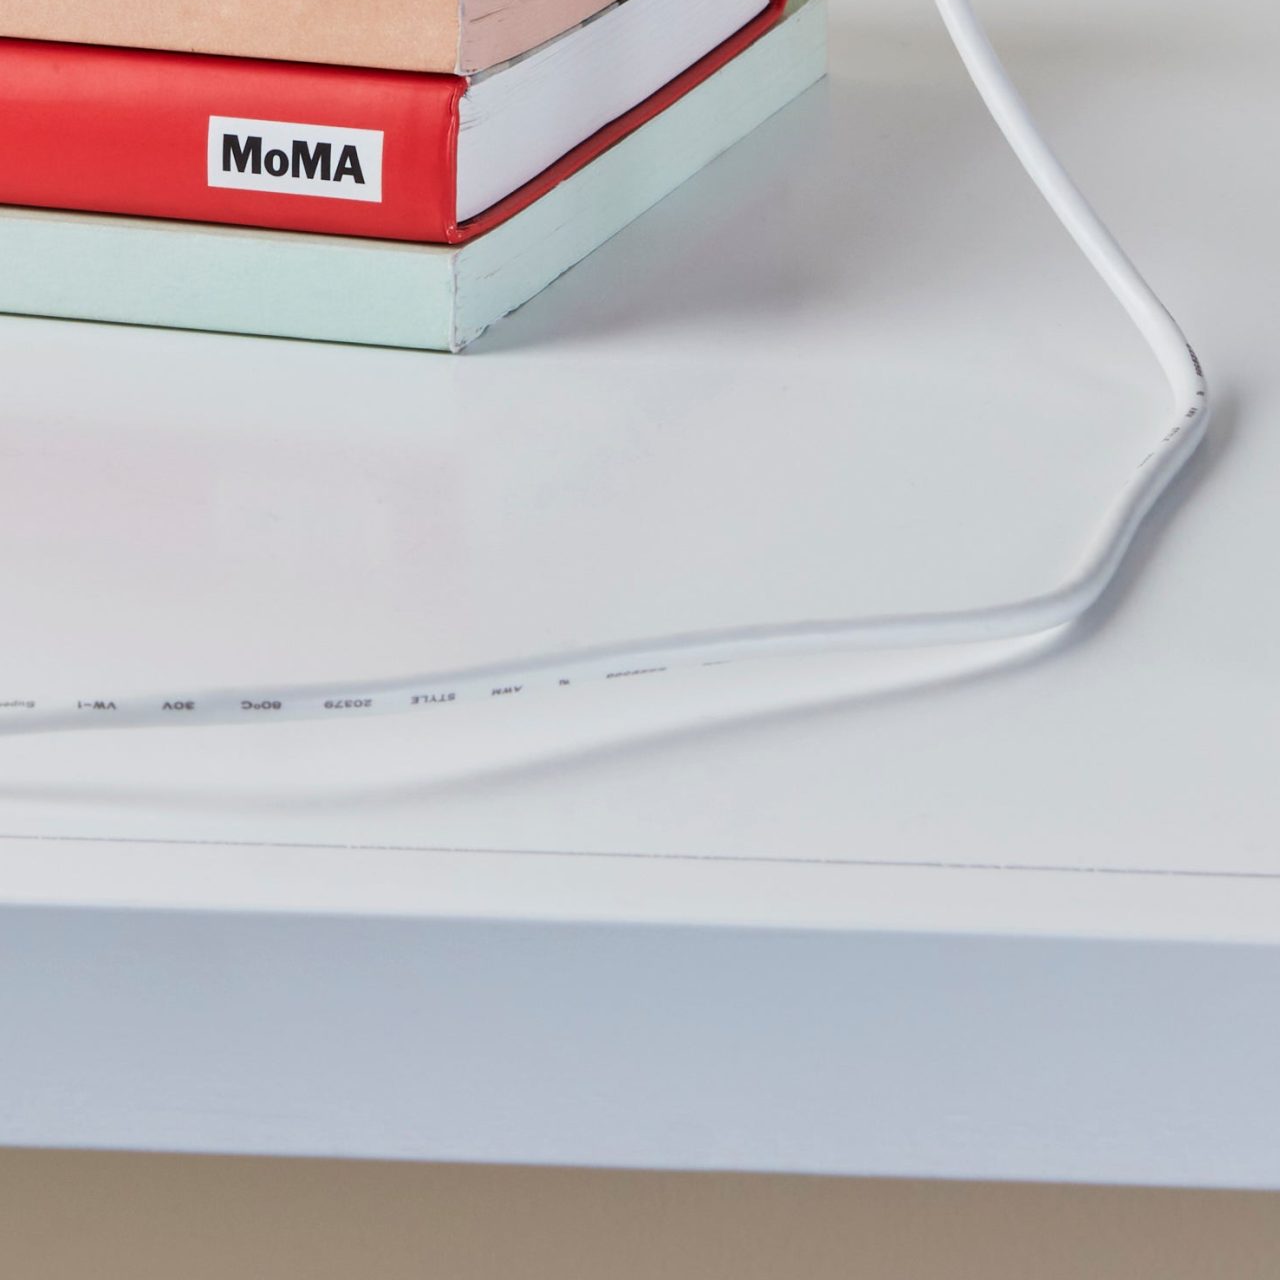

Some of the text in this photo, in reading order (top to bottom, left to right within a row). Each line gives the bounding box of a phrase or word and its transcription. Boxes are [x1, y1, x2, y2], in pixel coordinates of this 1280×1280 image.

[222, 133, 365, 185] MoMA
[411, 692, 456, 705] STYLE
[77, 700, 116, 711] VW-1
[162, 700, 195, 711] 30V
